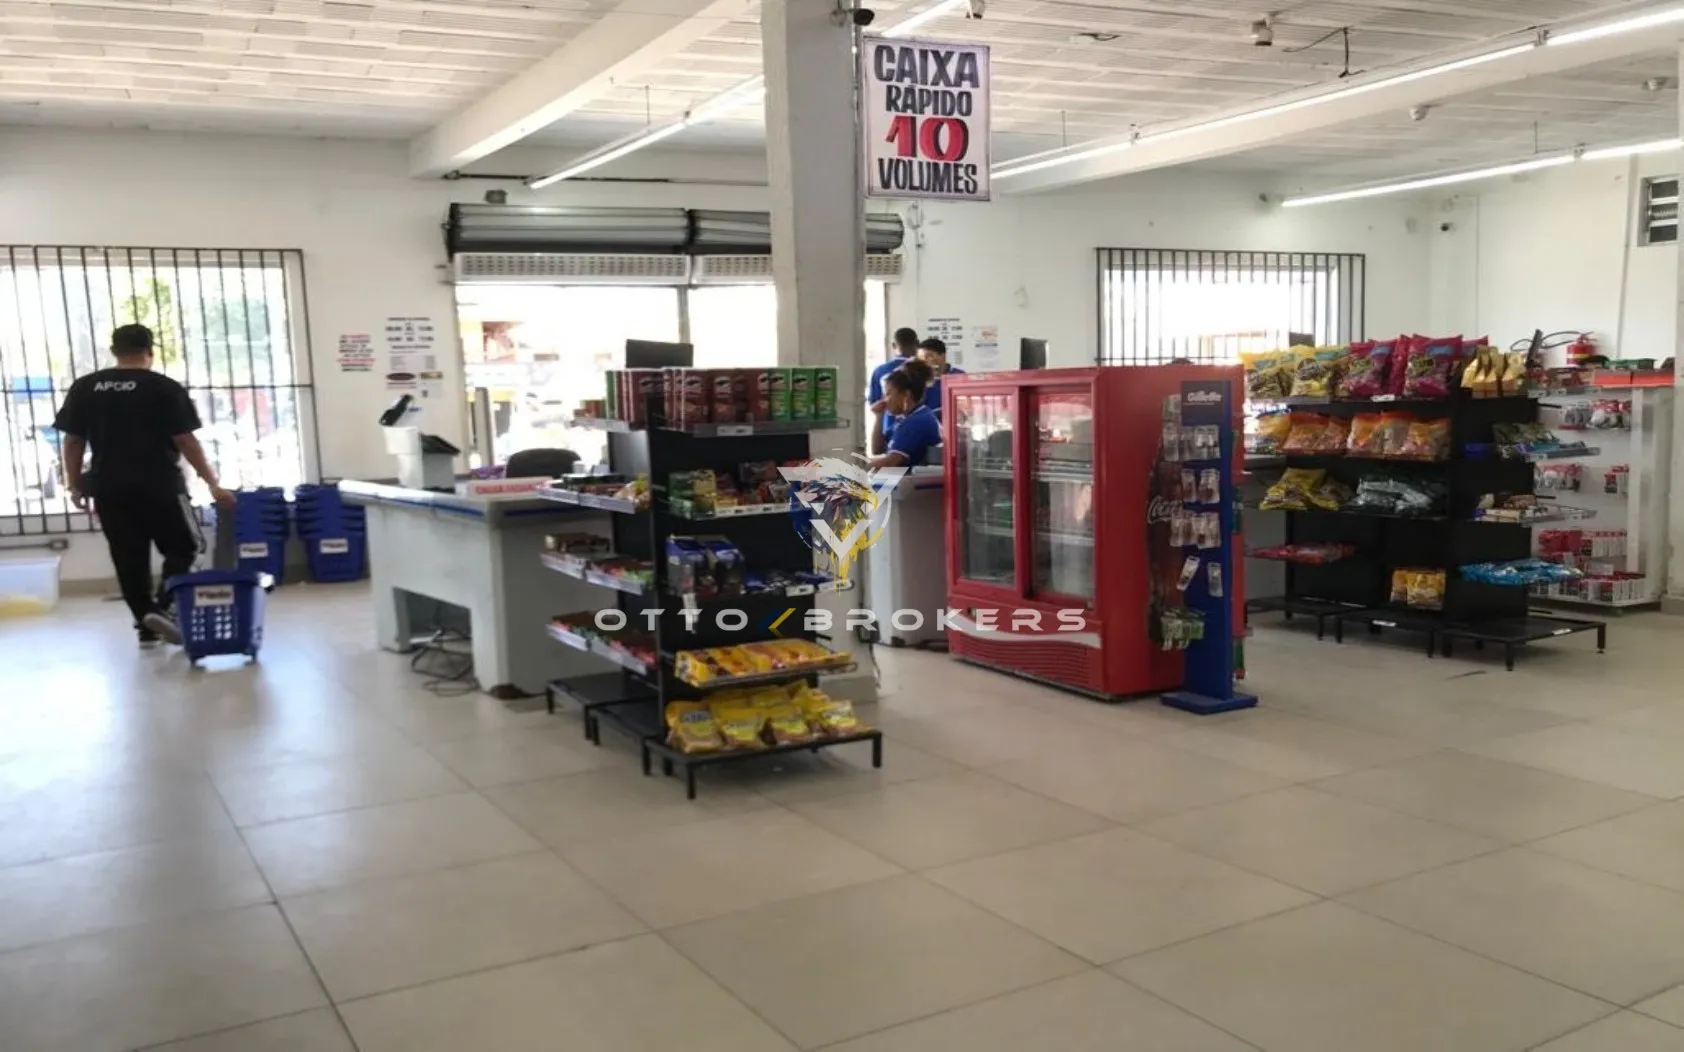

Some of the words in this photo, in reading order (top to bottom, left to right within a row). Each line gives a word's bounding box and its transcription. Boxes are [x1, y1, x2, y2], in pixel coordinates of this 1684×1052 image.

[874, 45, 980, 88] CAIXA
[885, 85, 973, 116] RÁPIDO
[885, 115, 969, 162] 10
[878, 158, 978, 194] VOLUMES
[1187, 390, 1222, 402] Gillette
